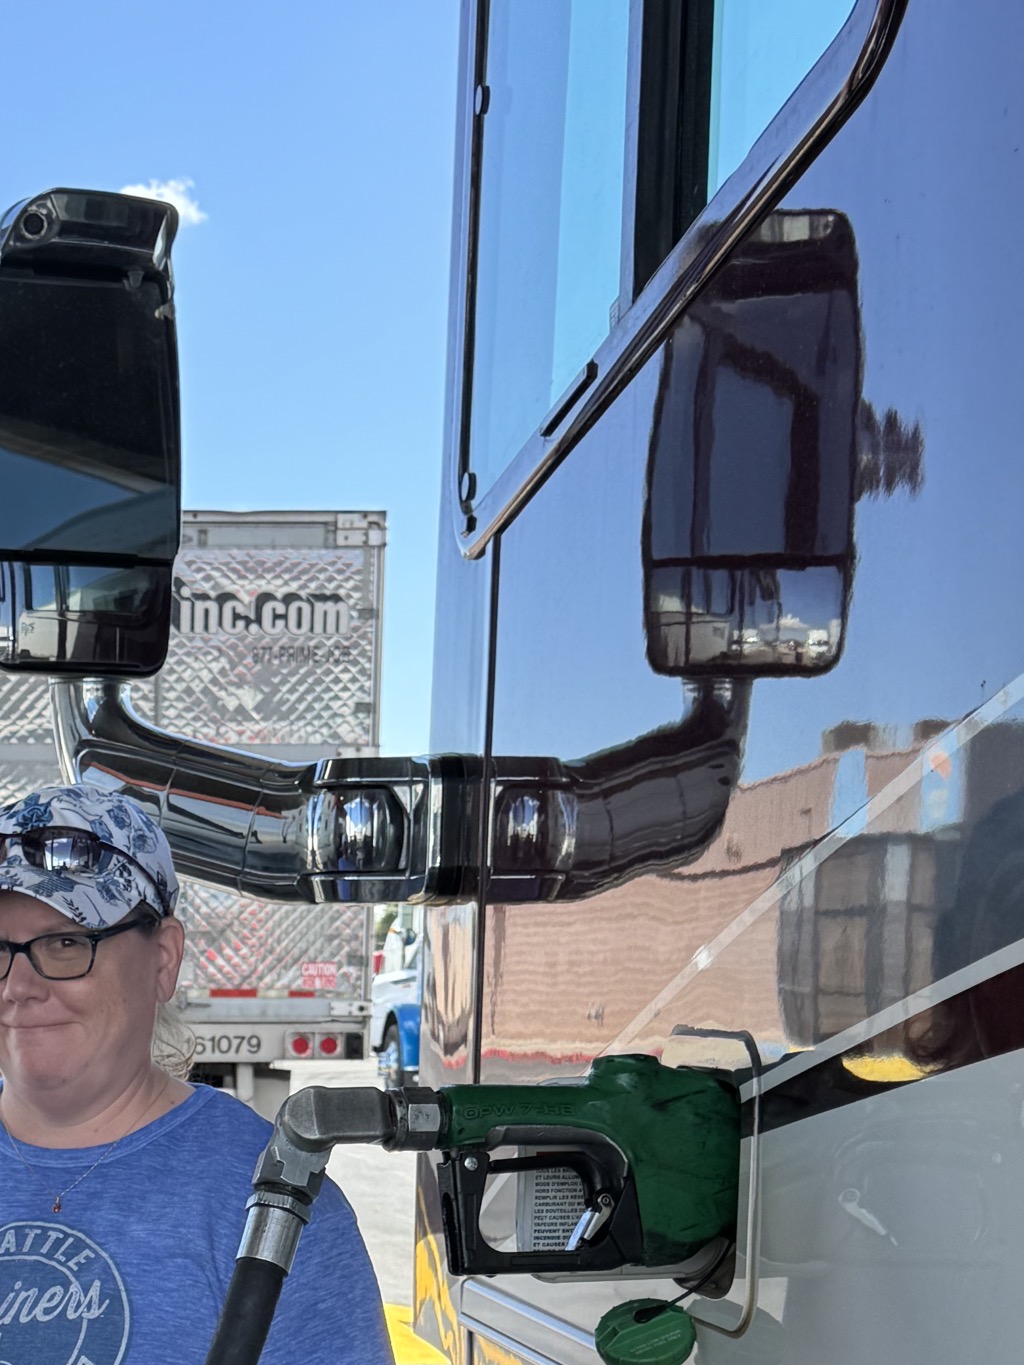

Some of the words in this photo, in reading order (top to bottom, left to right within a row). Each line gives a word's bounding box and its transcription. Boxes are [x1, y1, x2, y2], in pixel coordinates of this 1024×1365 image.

[173, 579, 350, 635] inc.com
[301, 962, 337, 976] CAUTION
[463, 1103, 515, 1120] OPW
